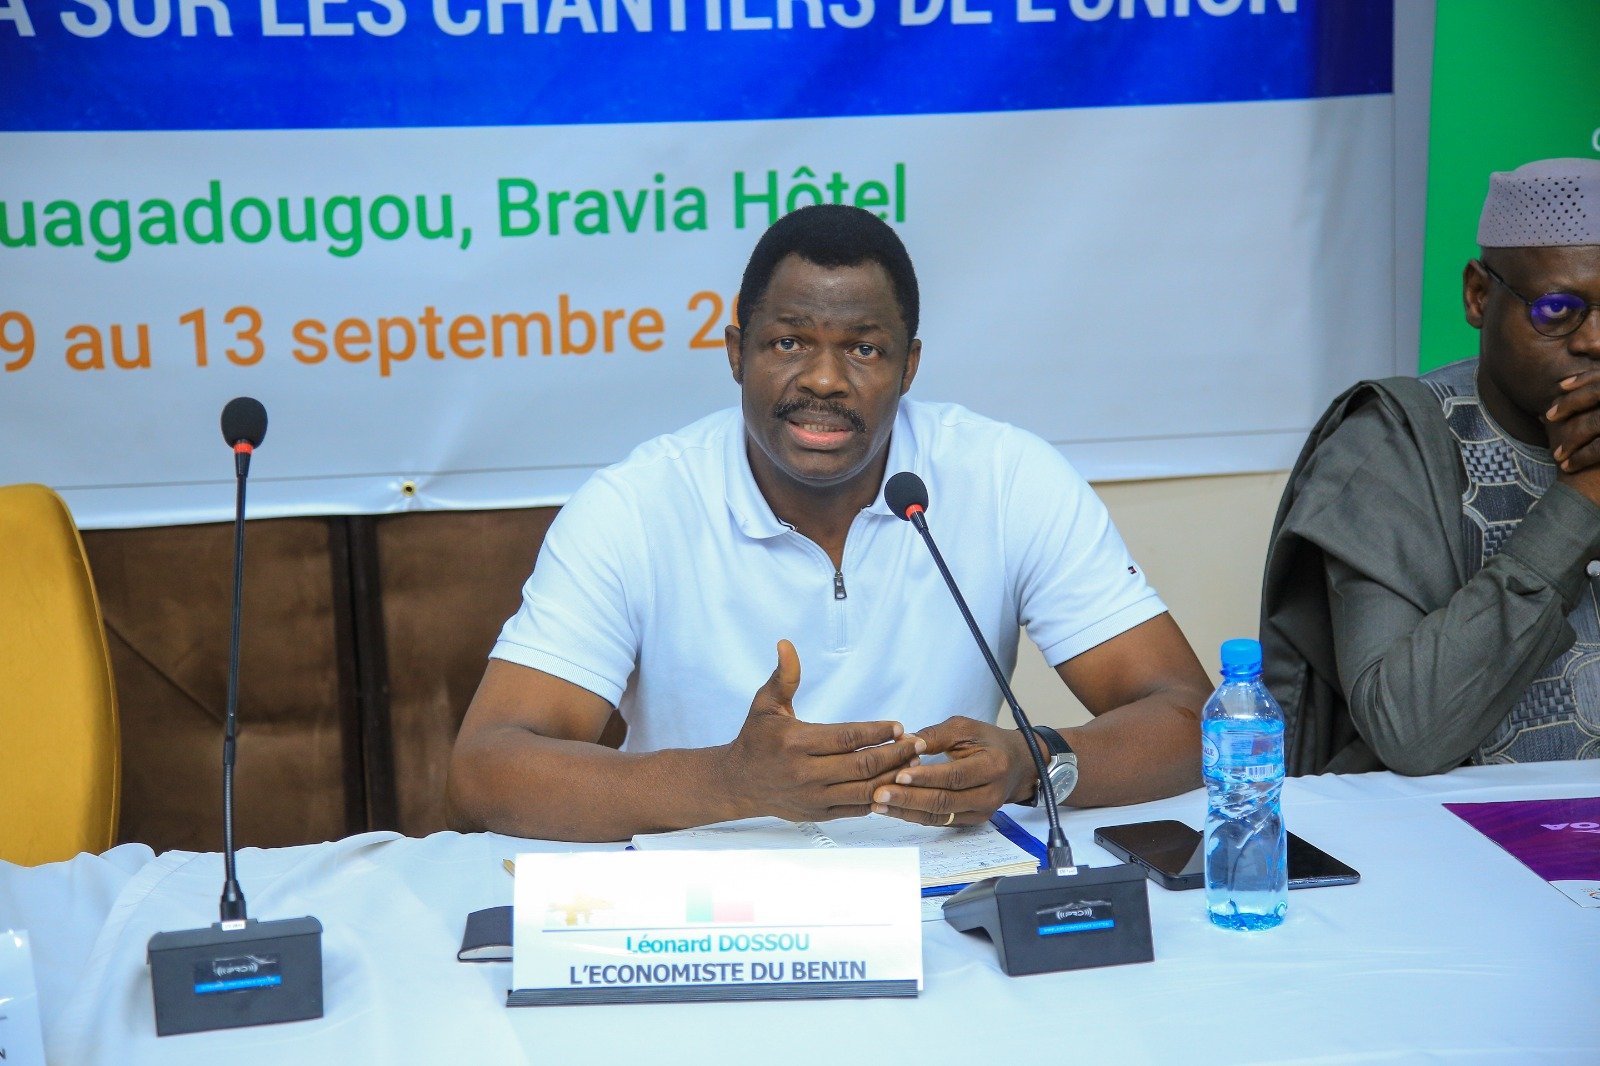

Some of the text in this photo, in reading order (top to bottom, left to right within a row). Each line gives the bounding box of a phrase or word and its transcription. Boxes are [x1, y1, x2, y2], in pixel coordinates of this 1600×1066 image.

[497, 173, 708, 237] Bravia
[64, 324, 152, 371] au
[178, 305, 266, 367] 13
[291, 293, 665, 378] septembre
[626, 933, 810, 954] Léonard DOSSOU
[569, 960, 867, 985] L'ECONOMISTE DU BENIN
